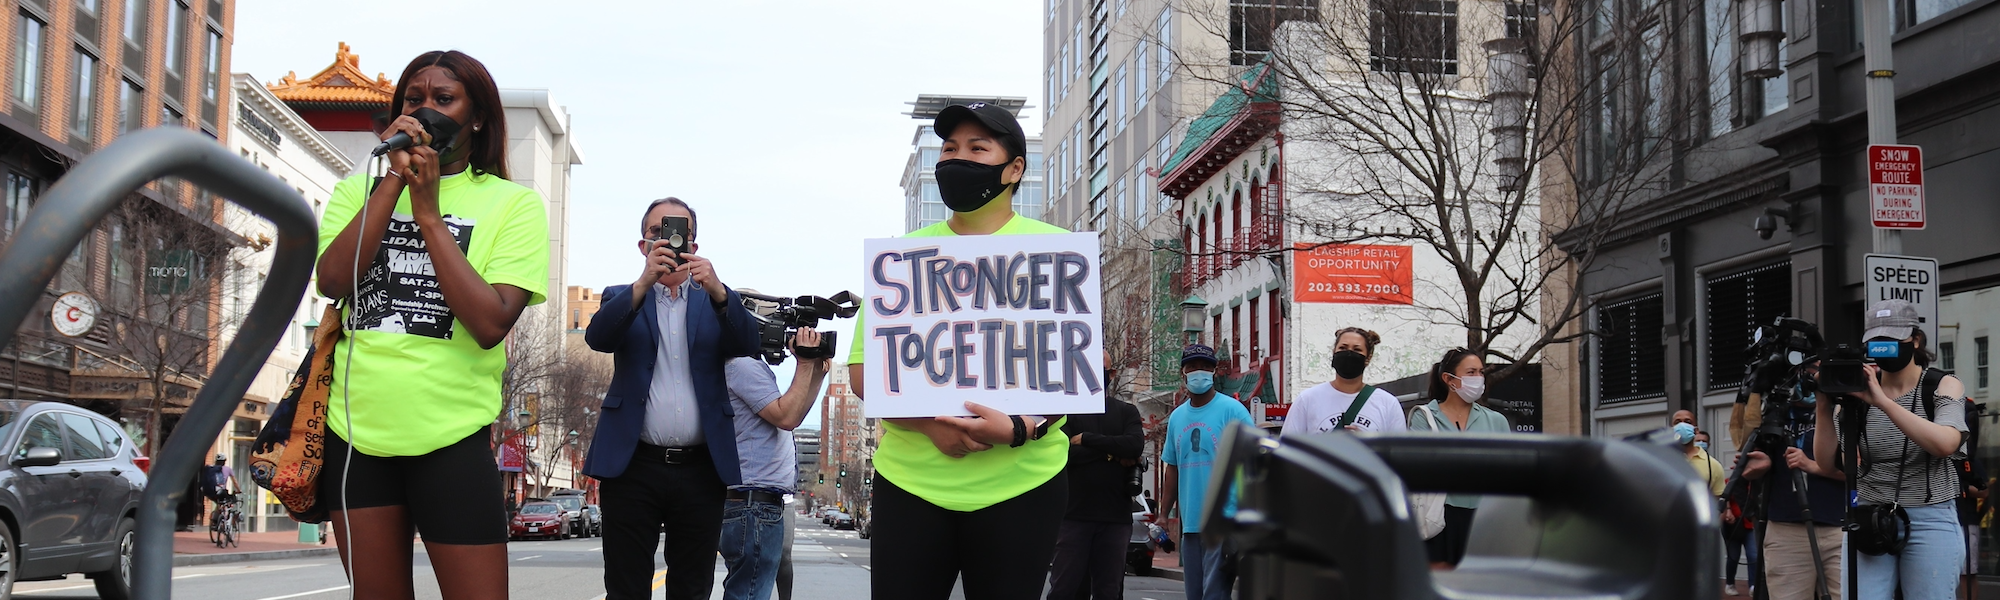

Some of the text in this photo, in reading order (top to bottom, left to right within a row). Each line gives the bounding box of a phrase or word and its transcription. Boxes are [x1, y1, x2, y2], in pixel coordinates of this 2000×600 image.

[1881, 149, 1909, 161] SNOW
[1875, 162, 1916, 171] EMERGENCY
[1882, 171, 1910, 183] ROUTE
[1876, 186, 1917, 196] NO PARKING
[1883, 198, 1912, 208] DURING
[1877, 209, 1920, 220] EMERGENCY
[1308, 248, 1400, 258] FLAGSHIP RETAIL
[1308, 258, 1400, 270] OPPORTUNITY
[1874, 266, 1929, 285] SPEED
[399, 277, 440, 289] SAT.3/
[870, 246, 1093, 318] STRONGER
[1308, 282, 1400, 294] 202.393.7000
[1881, 286, 1923, 304] LIMIT
[391, 299, 450, 312] Friendship Archway
[873, 319, 1103, 396] TOGETHER
[1329, 413, 1371, 428] POER
